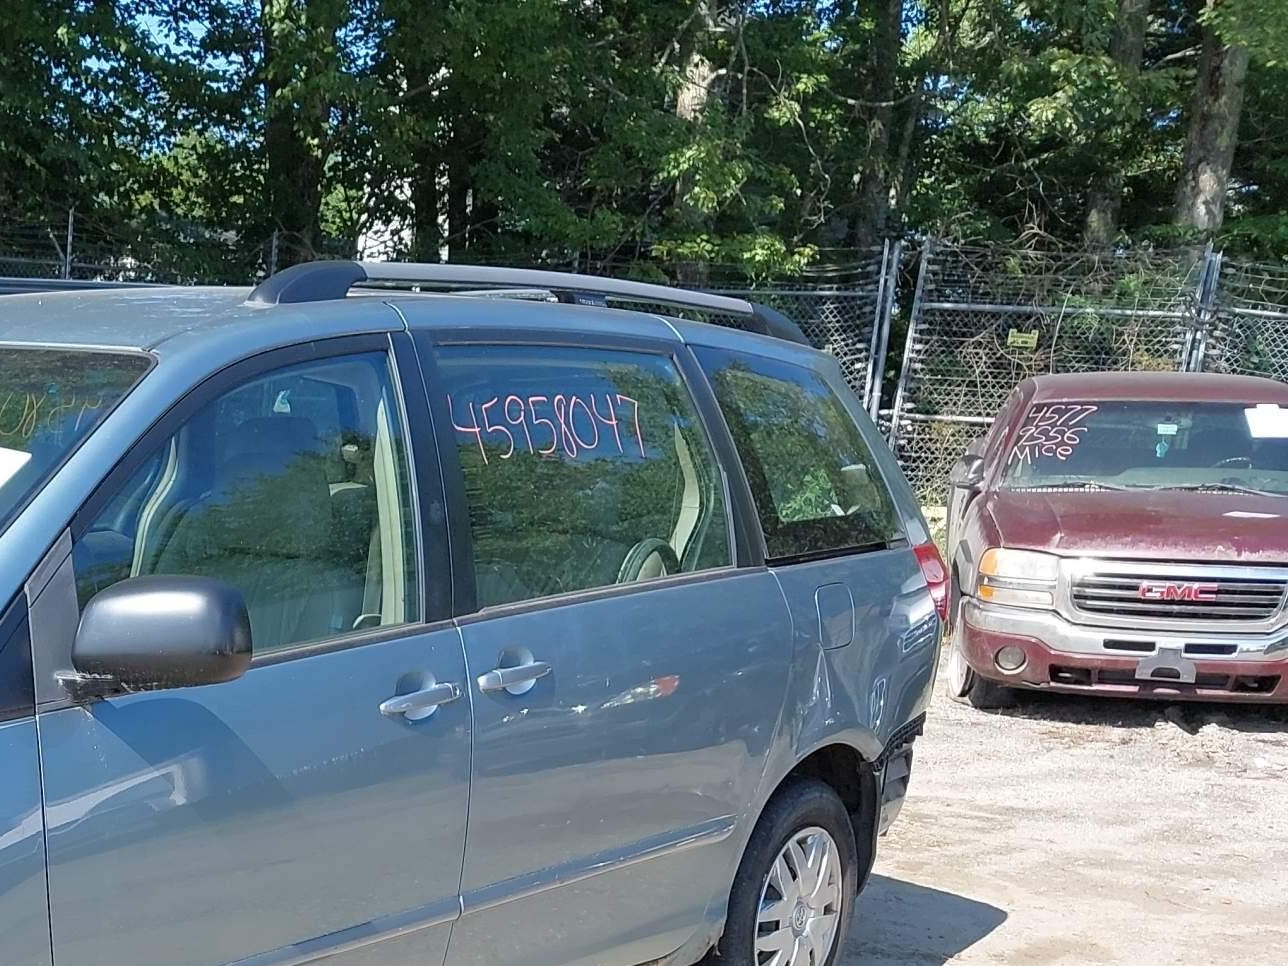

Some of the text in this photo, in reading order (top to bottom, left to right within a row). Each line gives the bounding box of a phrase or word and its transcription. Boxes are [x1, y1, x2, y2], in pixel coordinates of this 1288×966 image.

[1028, 405, 1098, 426] 4577
[446, 394, 647, 465] 45958047
[1017, 426, 1088, 446] 9556
[1138, 582, 1218, 601] GMC
